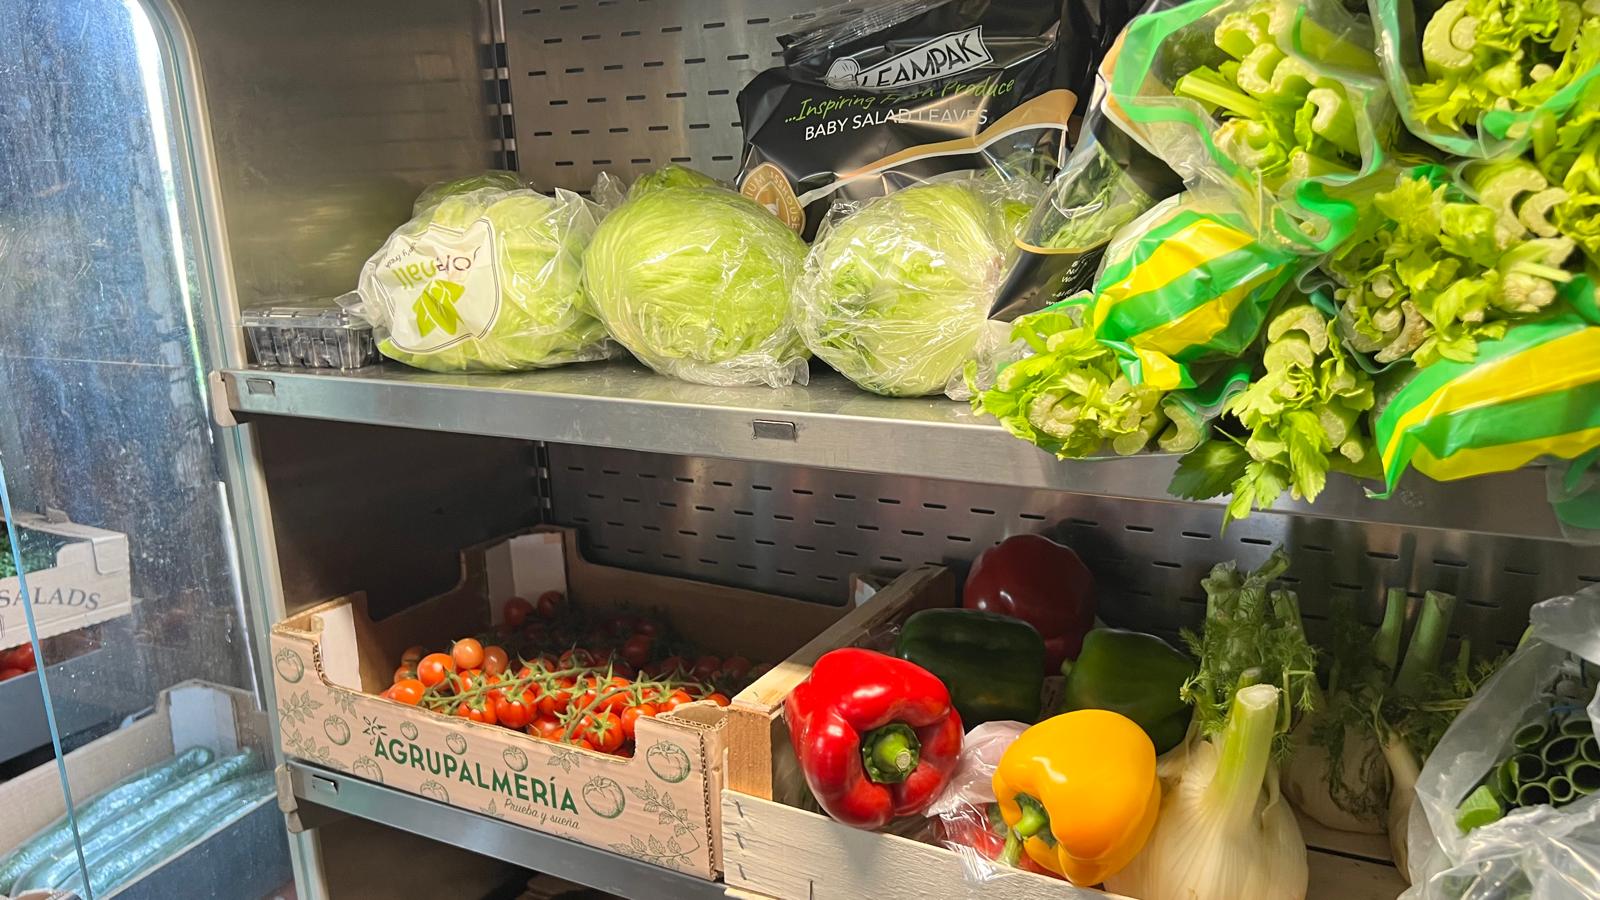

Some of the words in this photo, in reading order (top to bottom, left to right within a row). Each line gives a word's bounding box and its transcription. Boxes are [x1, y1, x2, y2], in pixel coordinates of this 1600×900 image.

[941, 78, 1016, 102] Produce
[804, 117, 849, 141] BABY
[852, 108, 910, 129] SALAD
[0, 587, 101, 610] SALADS
[374, 735, 579, 815] AGRUPALMERÍA
[504, 798, 540, 818] Prueba
[539, 814, 548, 825] y
